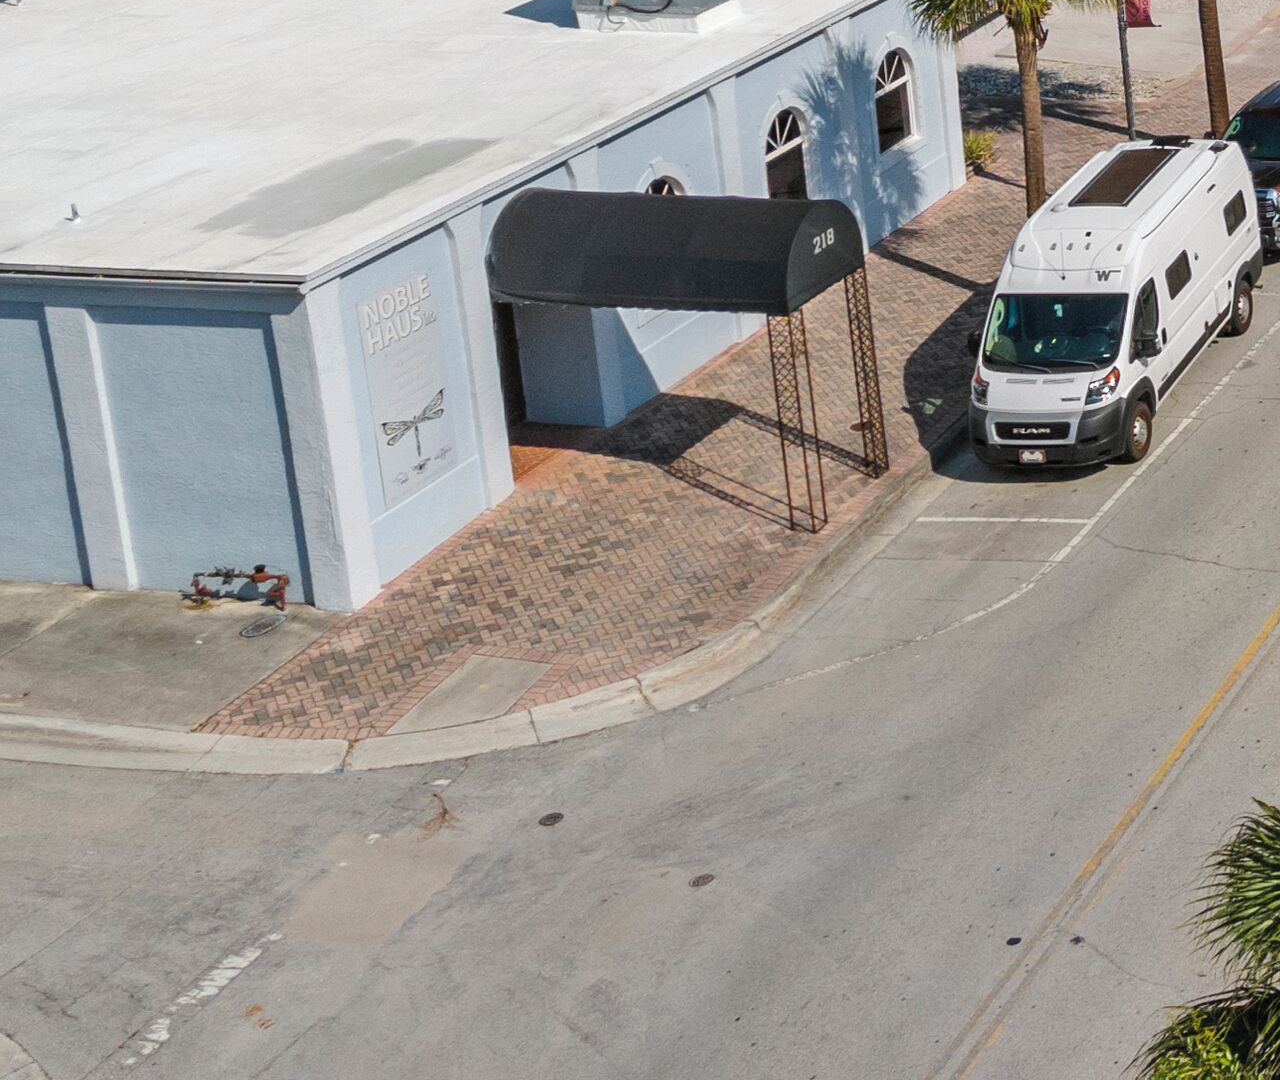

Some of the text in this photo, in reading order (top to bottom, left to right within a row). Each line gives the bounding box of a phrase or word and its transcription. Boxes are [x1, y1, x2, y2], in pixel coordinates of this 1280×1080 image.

[812, 227, 835, 255] 218
[364, 274, 431, 330] NOBLE
[368, 306, 423, 356] HAUS
